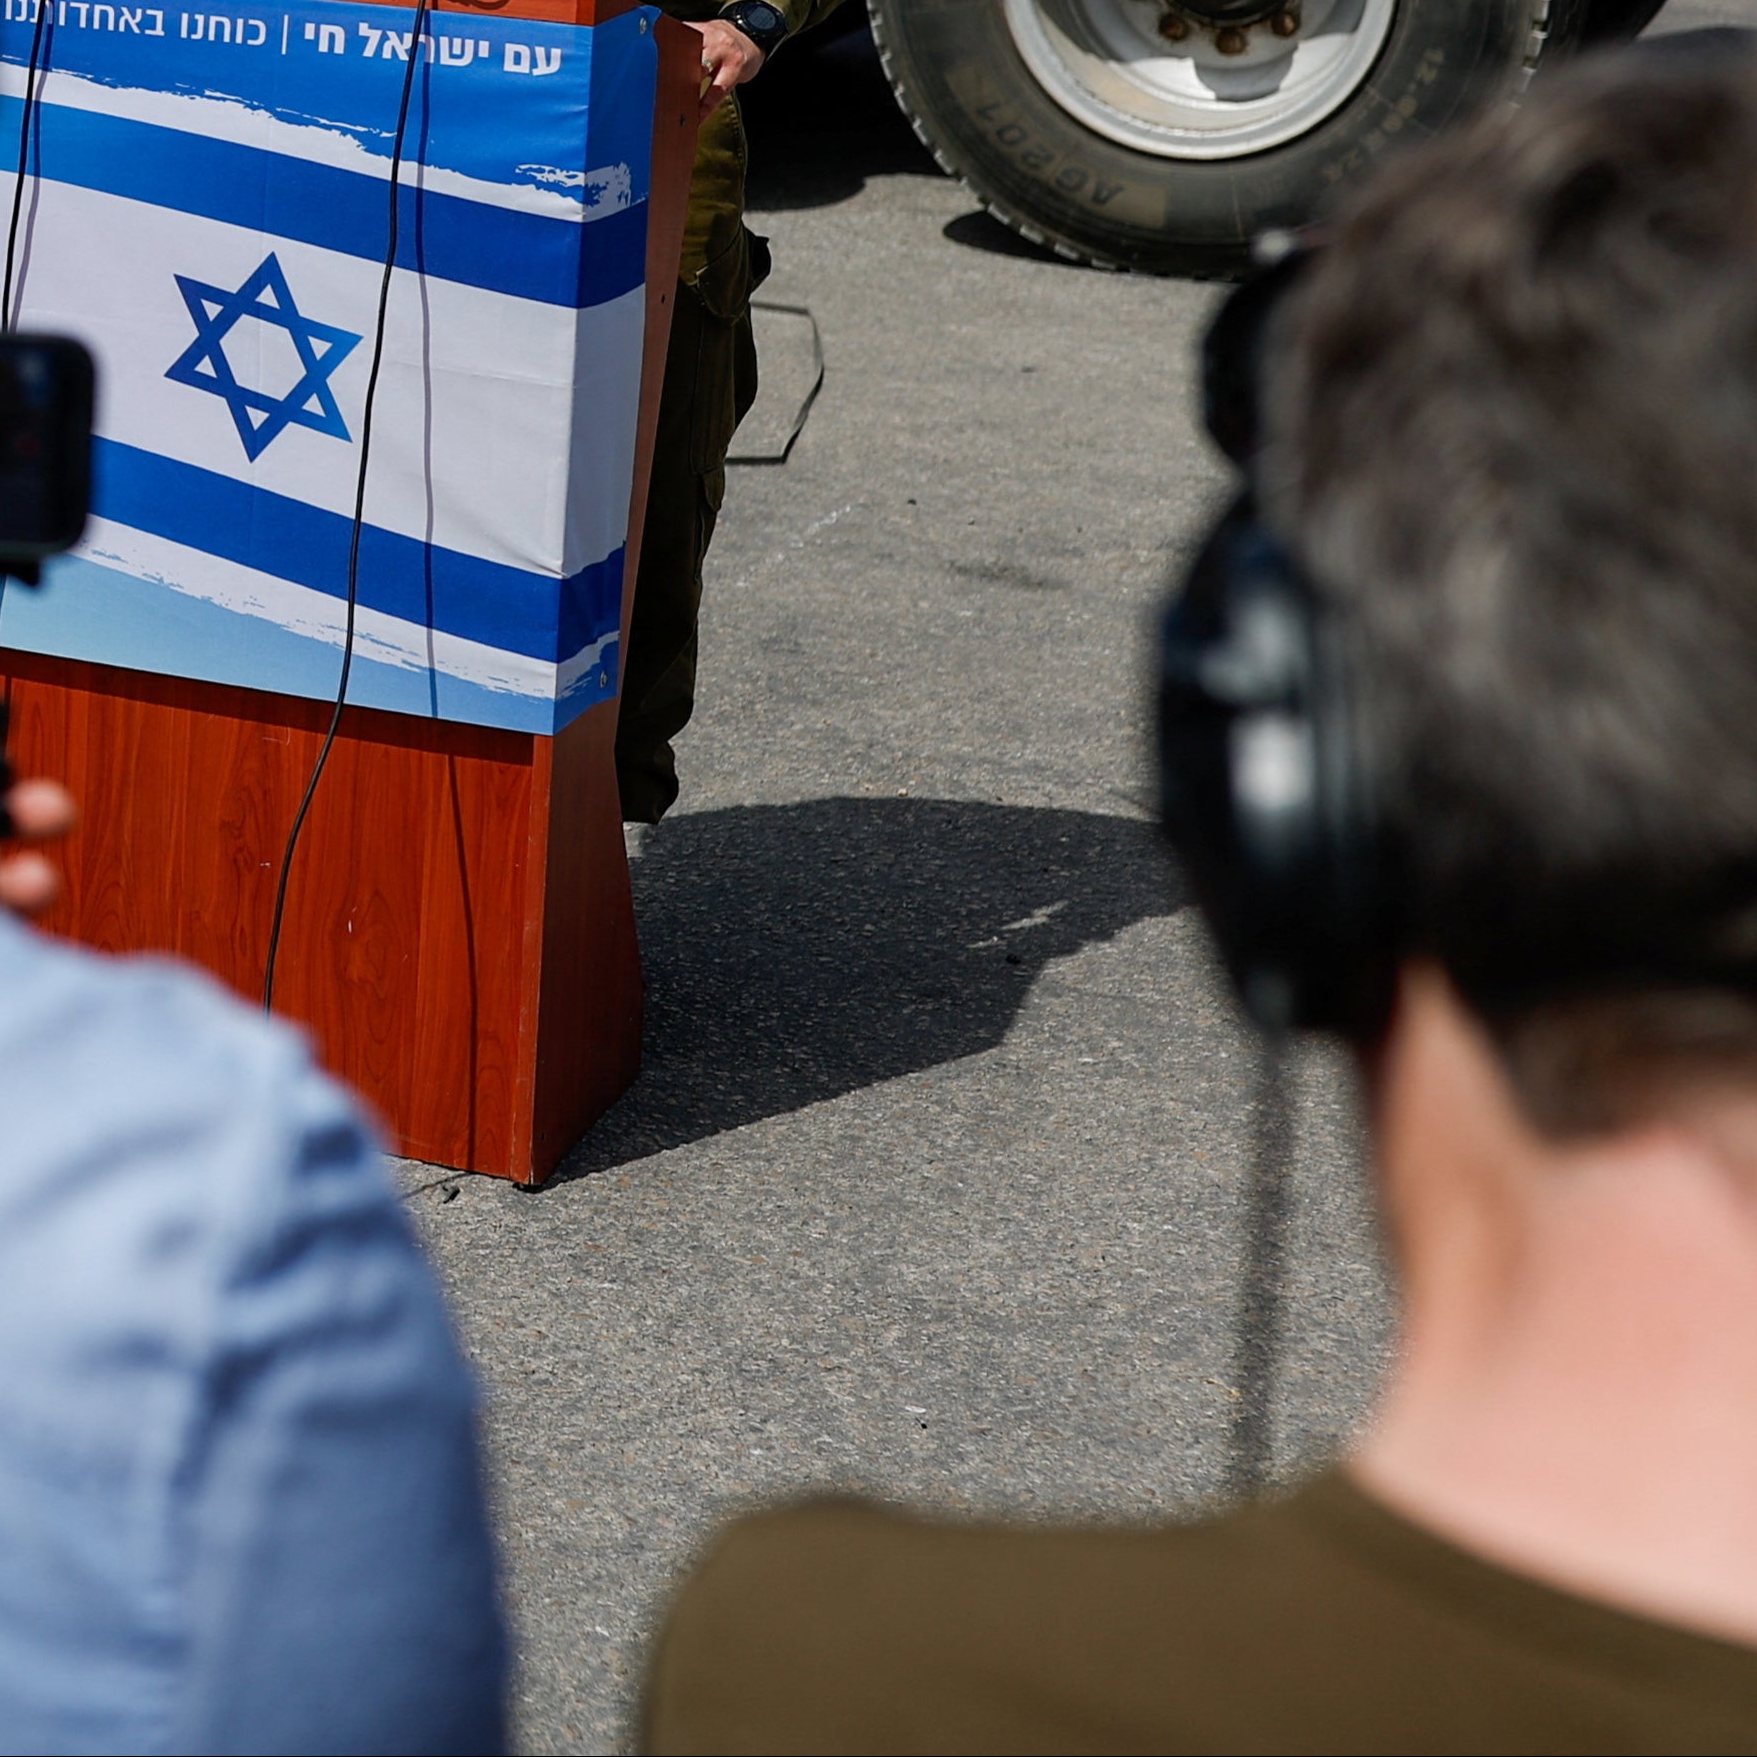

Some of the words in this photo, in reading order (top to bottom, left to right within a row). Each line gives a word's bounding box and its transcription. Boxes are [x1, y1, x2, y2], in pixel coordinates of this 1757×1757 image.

[180, 12, 268, 46] כוחנו
[304, 22, 346, 55] חי
[358, 22, 490, 68] ישראל
[503, 42, 563, 76] עם
